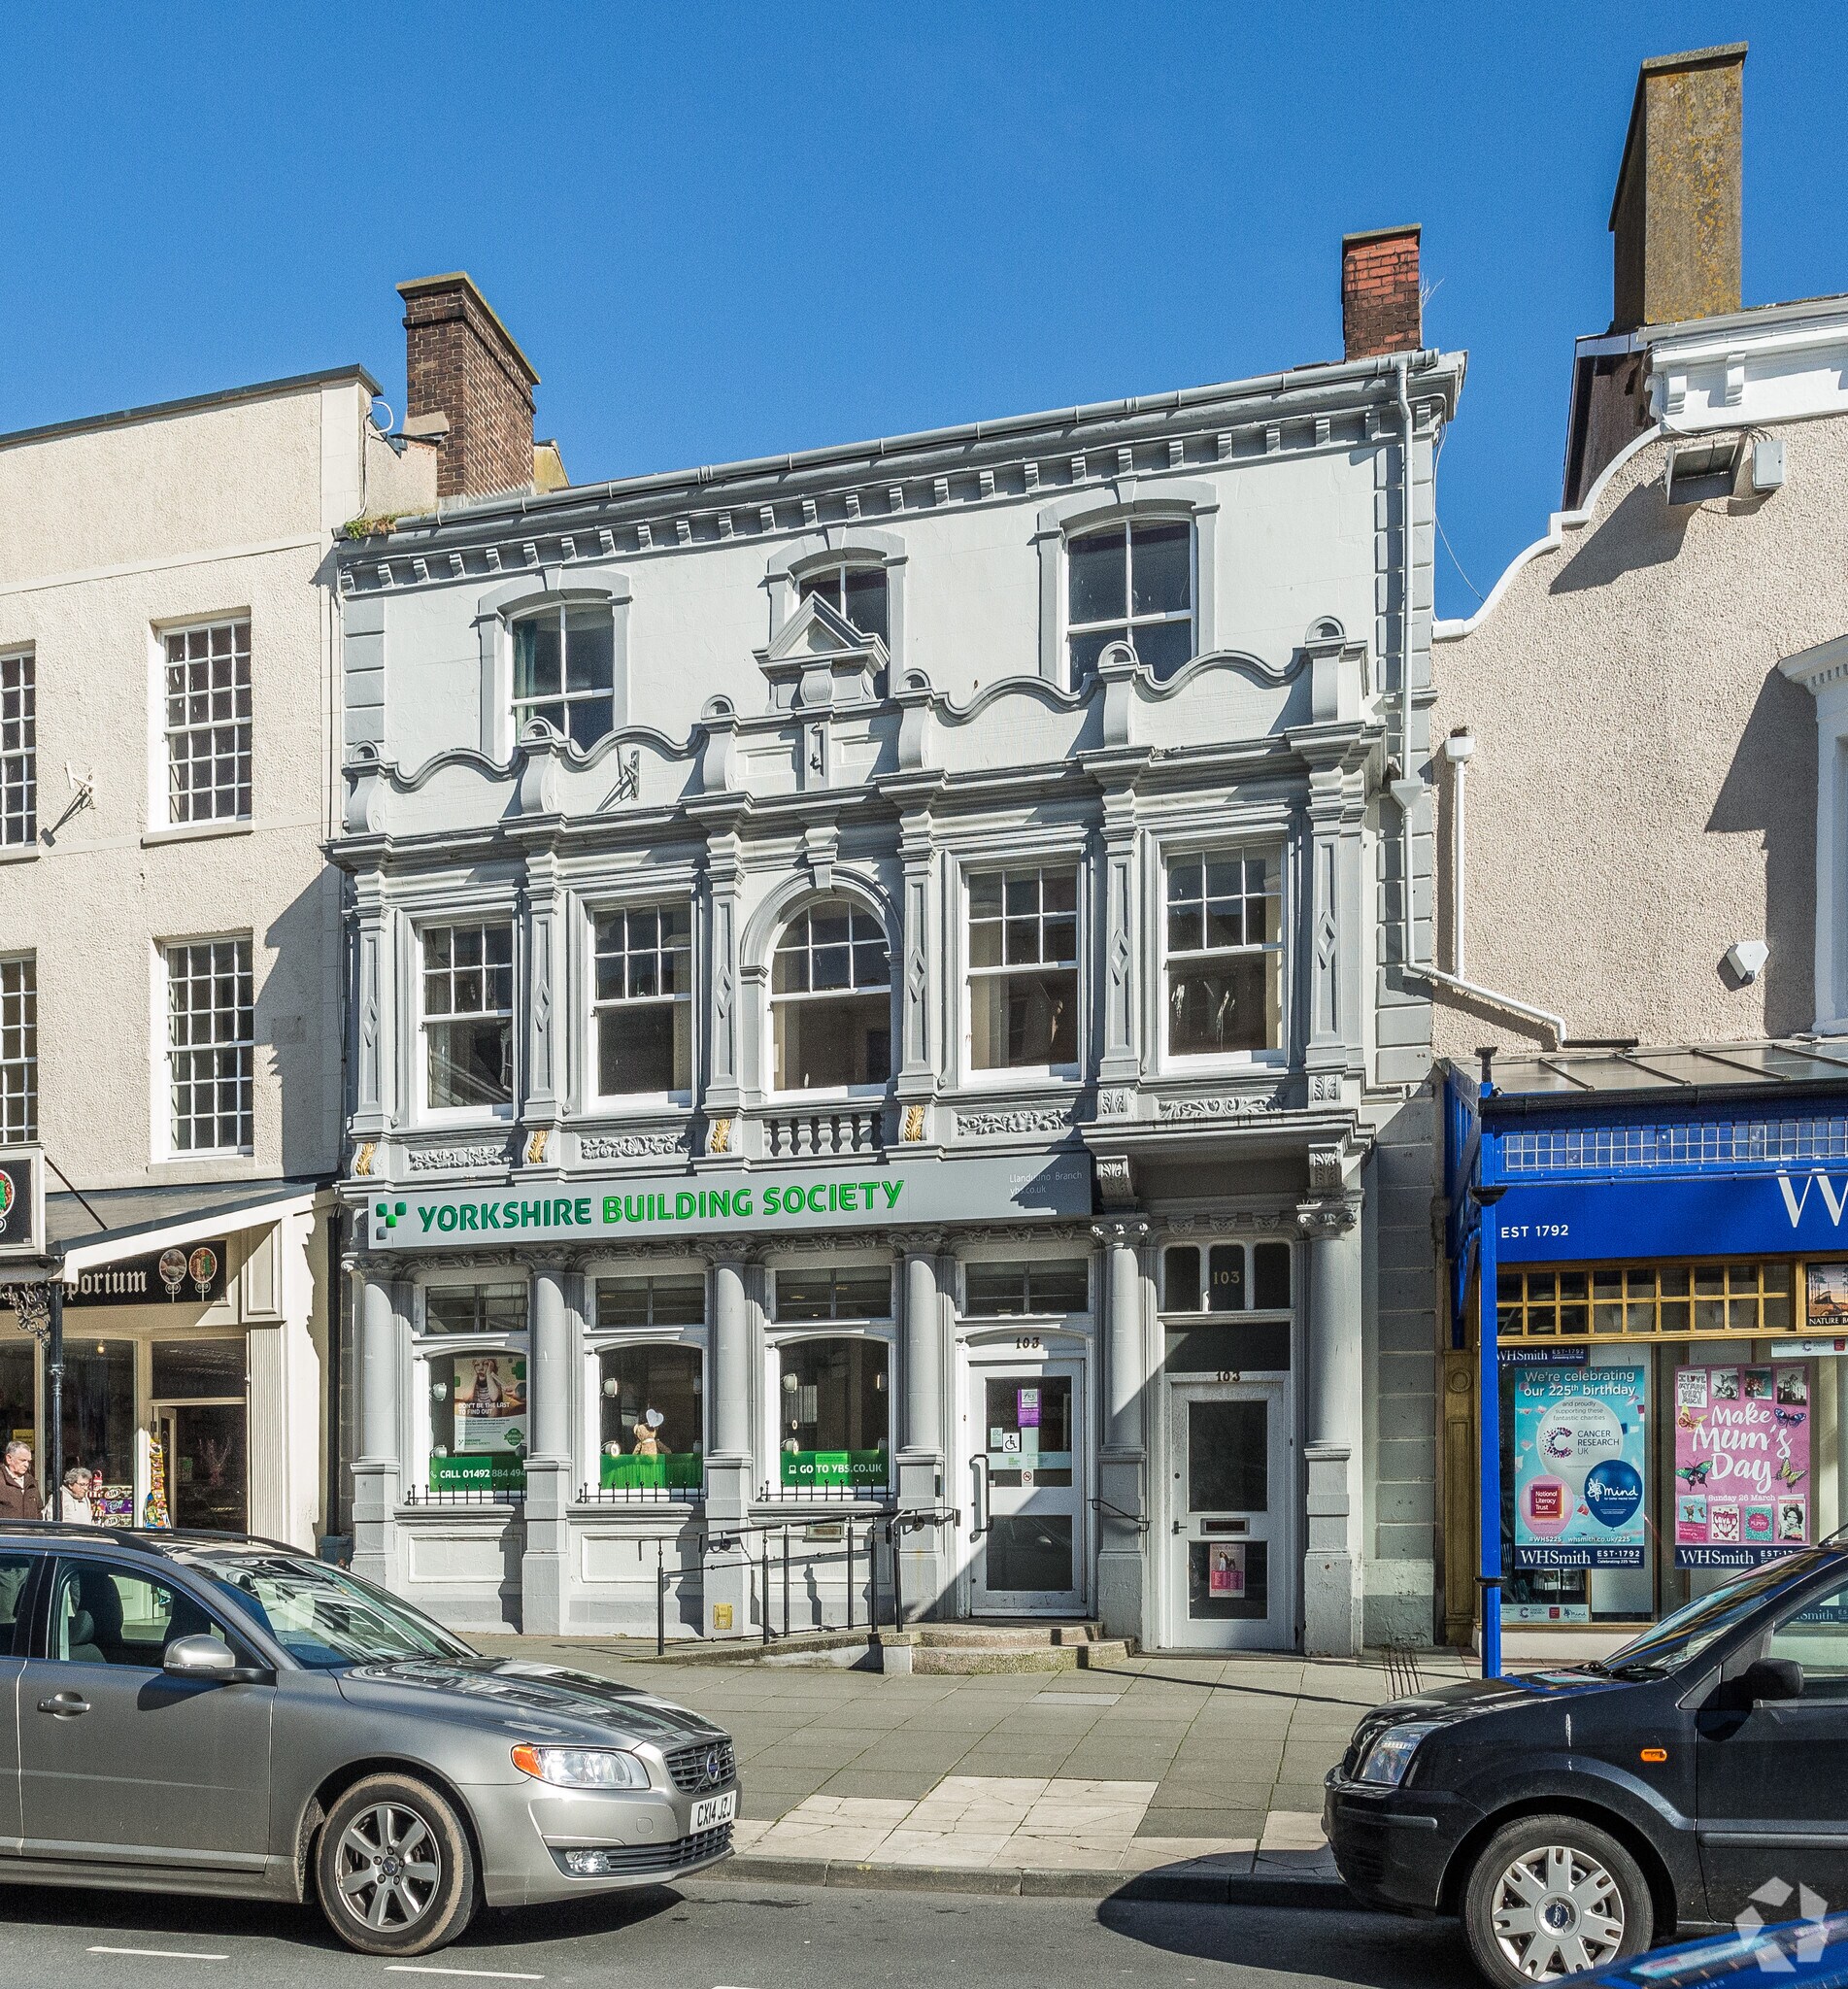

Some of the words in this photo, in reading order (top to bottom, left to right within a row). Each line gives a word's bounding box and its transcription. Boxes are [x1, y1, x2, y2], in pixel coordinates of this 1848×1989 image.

[1055, 1170, 1083, 1181] Branch
[419, 1197, 592, 1232] YORKSHIRE
[602, 1189, 753, 1224] BUILDING
[763, 1180, 904, 1216] SOCIETY
[1501, 1226, 1529, 1238] EST
[1536, 1224, 1569, 1237] 1792
[62, 1264, 148, 1301] porium
[1213, 1270, 1241, 1285] 103
[1016, 1336, 1040, 1349] 103
[1216, 1370, 1241, 1382] 103
[1525, 1371, 1561, 1382] We're
[1564, 1369, 1635, 1383] celebrating
[1524, 1387, 1545, 1397] our
[1548, 1384, 1579, 1397] 225th
[1583, 1384, 1636, 1397] birthday
[1710, 1401, 1772, 1426] Make
[1577, 1437, 1620, 1446] RESEARCH
[1692, 1424, 1793, 1458] Mum's
[440, 1468, 461, 1479] CALL
[462, 1468, 490, 1479] 01492
[491, 1468, 509, 1477] 884
[510, 1468, 526, 1477] 494
[799, 1464, 814, 1474] GO
[816, 1464, 829, 1473] TO
[831, 1463, 883, 1473] YBS.CO.UK
[1709, 1452, 1772, 1494] Day
[1603, 1485, 1639, 1498] mind
[1708, 1494, 1737, 1502] Sunday
[1520, 1549, 1592, 1565] WHSmith
[1680, 1549, 1755, 1565] WHSmith
[697, 1800, 717, 1828] CX14
[718, 1795, 733, 1821] JZJ
